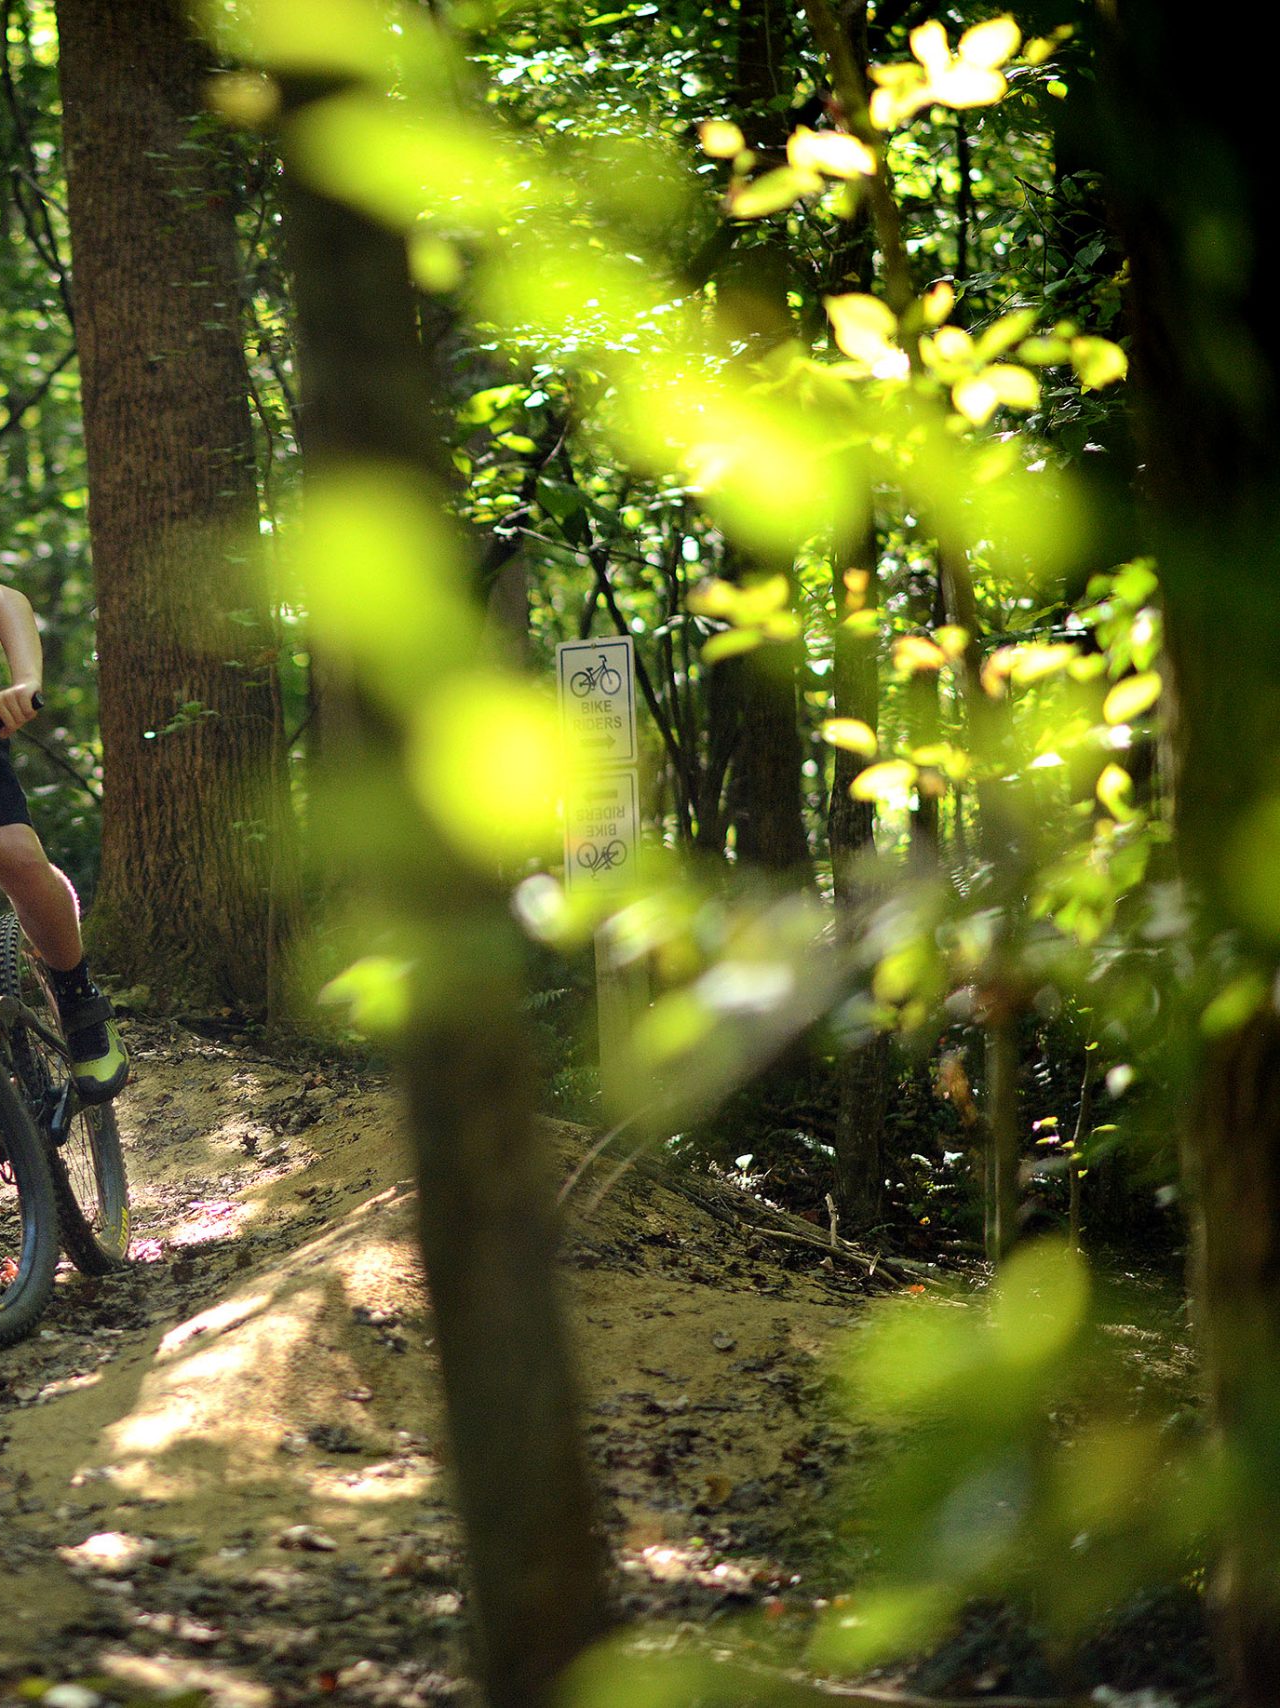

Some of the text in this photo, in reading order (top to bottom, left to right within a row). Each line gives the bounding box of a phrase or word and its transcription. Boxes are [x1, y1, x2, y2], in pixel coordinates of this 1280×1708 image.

[582, 700, 613, 714] BIKE
[573, 716, 622, 732] RIDERS
[576, 805, 625, 821] RIDERS
[586, 823, 617, 837] BIKE
